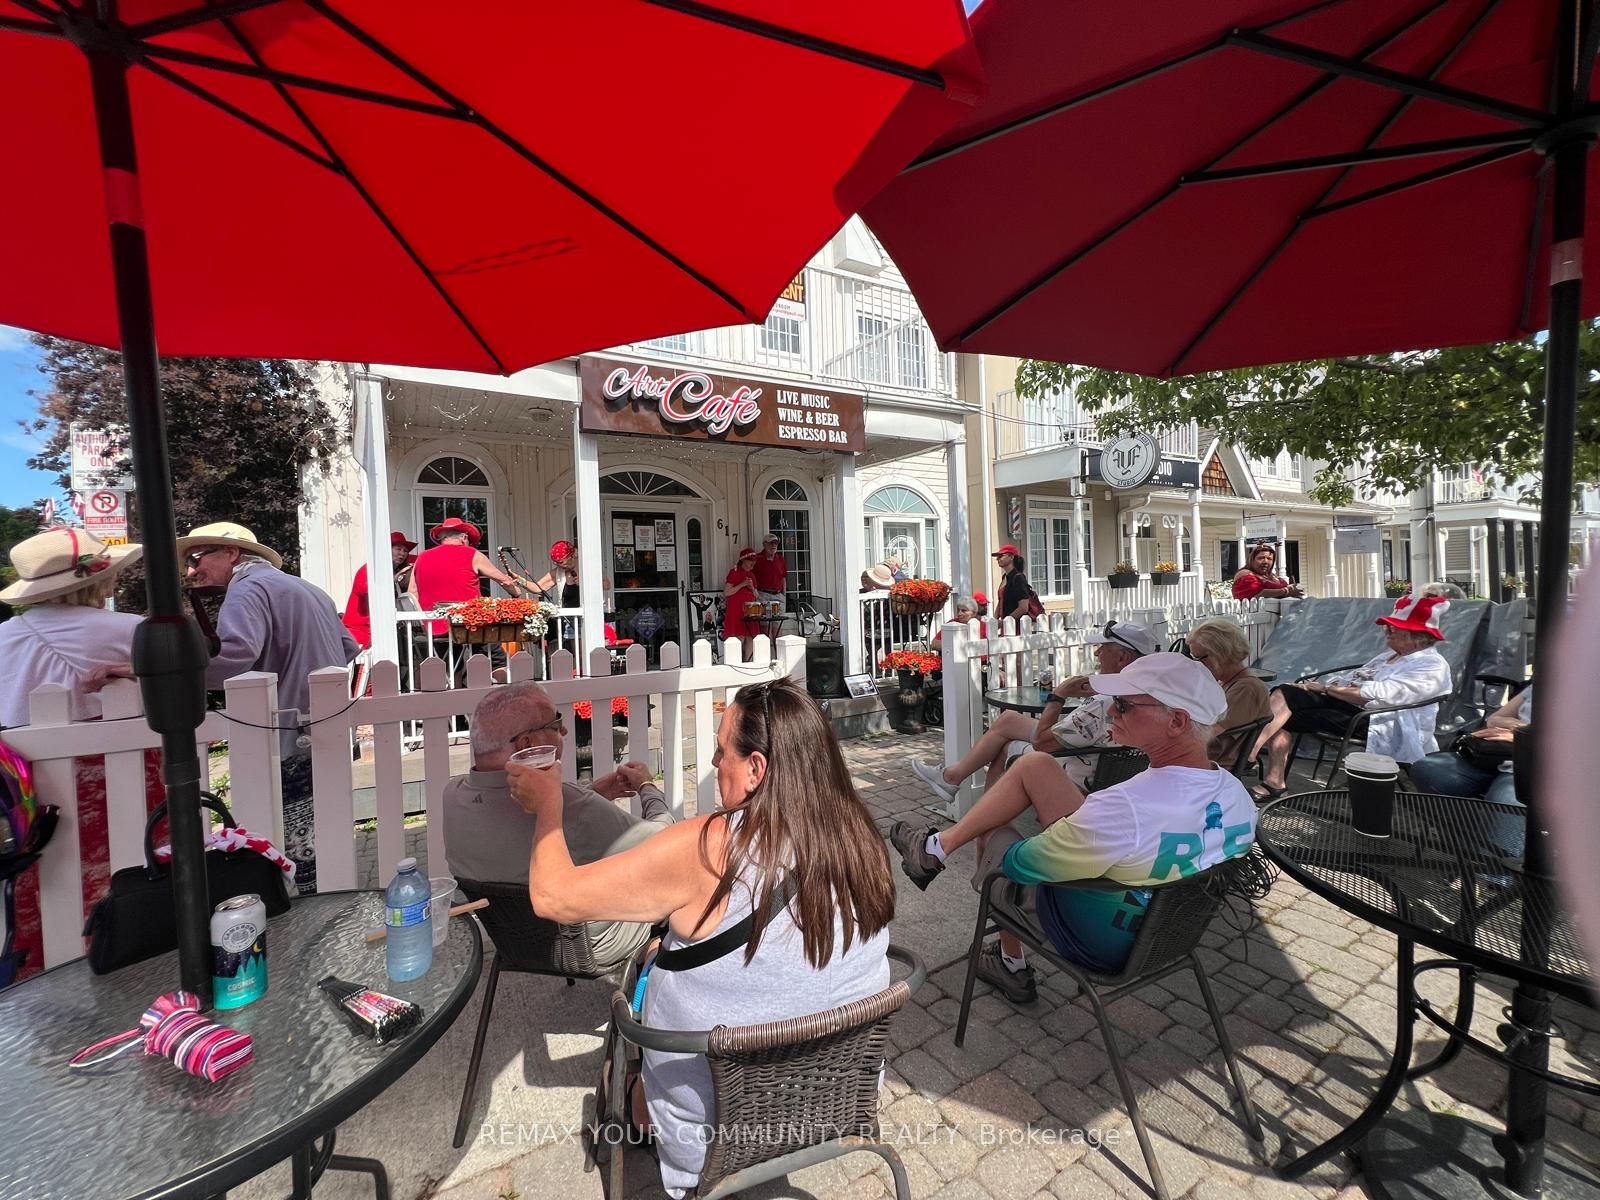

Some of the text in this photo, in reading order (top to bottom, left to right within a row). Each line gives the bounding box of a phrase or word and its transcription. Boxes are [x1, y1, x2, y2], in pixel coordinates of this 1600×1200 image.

[603, 365, 669, 399] Art
[659, 372, 763, 435] Café
[776, 389, 831, 410] LIVE MUSIC
[777, 407, 840, 427] WINE & BEER
[778, 424, 848, 444] ESPRESSO BAR
[1156, 461, 1172, 476] DIO
